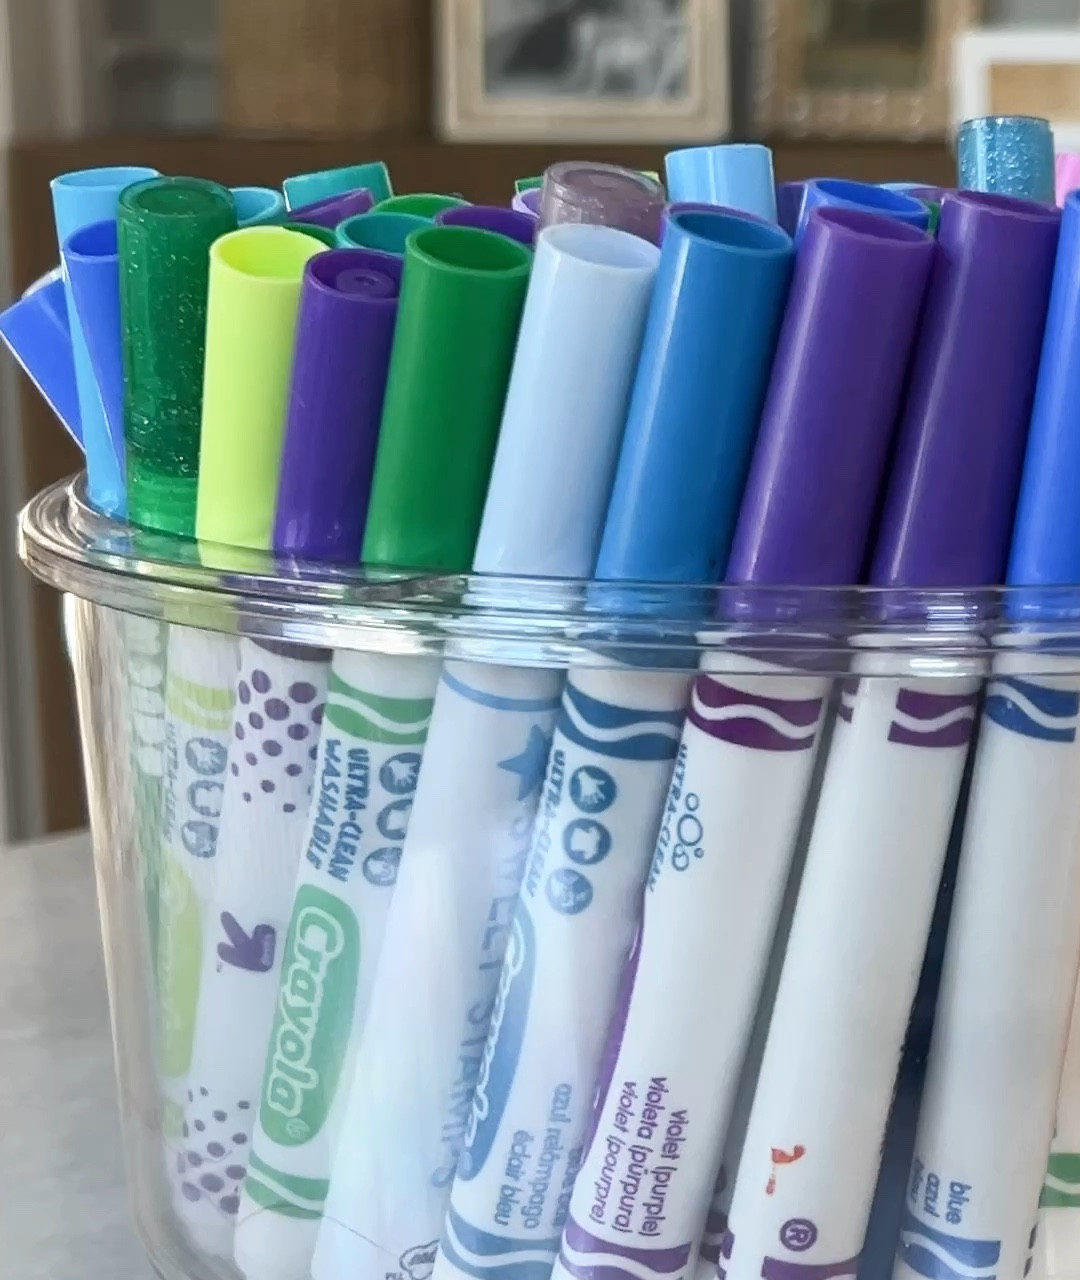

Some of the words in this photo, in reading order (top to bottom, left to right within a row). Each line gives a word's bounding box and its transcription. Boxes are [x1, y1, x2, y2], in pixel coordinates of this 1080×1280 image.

[306, 739, 341, 870] WASHABLE
[328, 748, 370, 882] ULTRA-CLEAN
[551, 1083, 573, 1123] azul
[613, 1081, 639, 1133] violet
[637, 1077, 669, 1140] violeta
[505, 1130, 535, 1181] éclair
[660, 1110, 690, 1160] violet
[494, 1184, 522, 1227] bleu
[521, 1128, 565, 1229] relámpago
[589, 1135, 627, 1225] (pourpre)
[612, 1145, 654, 1233] (púrpura)
[638, 1166, 678, 1238] (purple)
[924, 1173, 940, 1218] azul
[946, 1181, 972, 1225] blue
